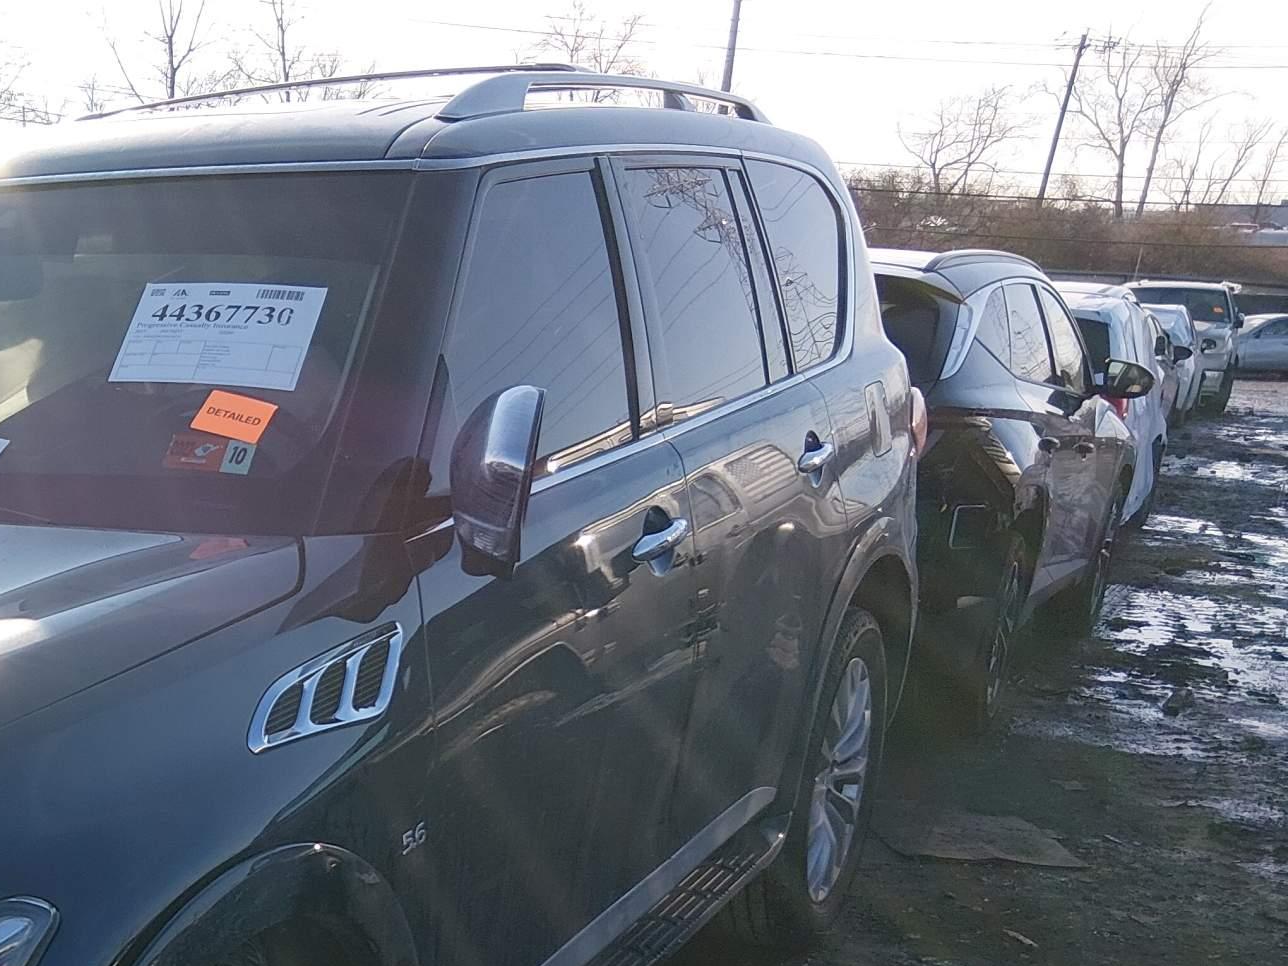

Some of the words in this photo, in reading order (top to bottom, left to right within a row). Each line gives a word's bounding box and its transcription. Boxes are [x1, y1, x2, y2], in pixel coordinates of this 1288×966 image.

[152, 304, 295, 326] 44367730
[206, 406, 262, 426] DETAILED
[228, 446, 248, 465] 10
